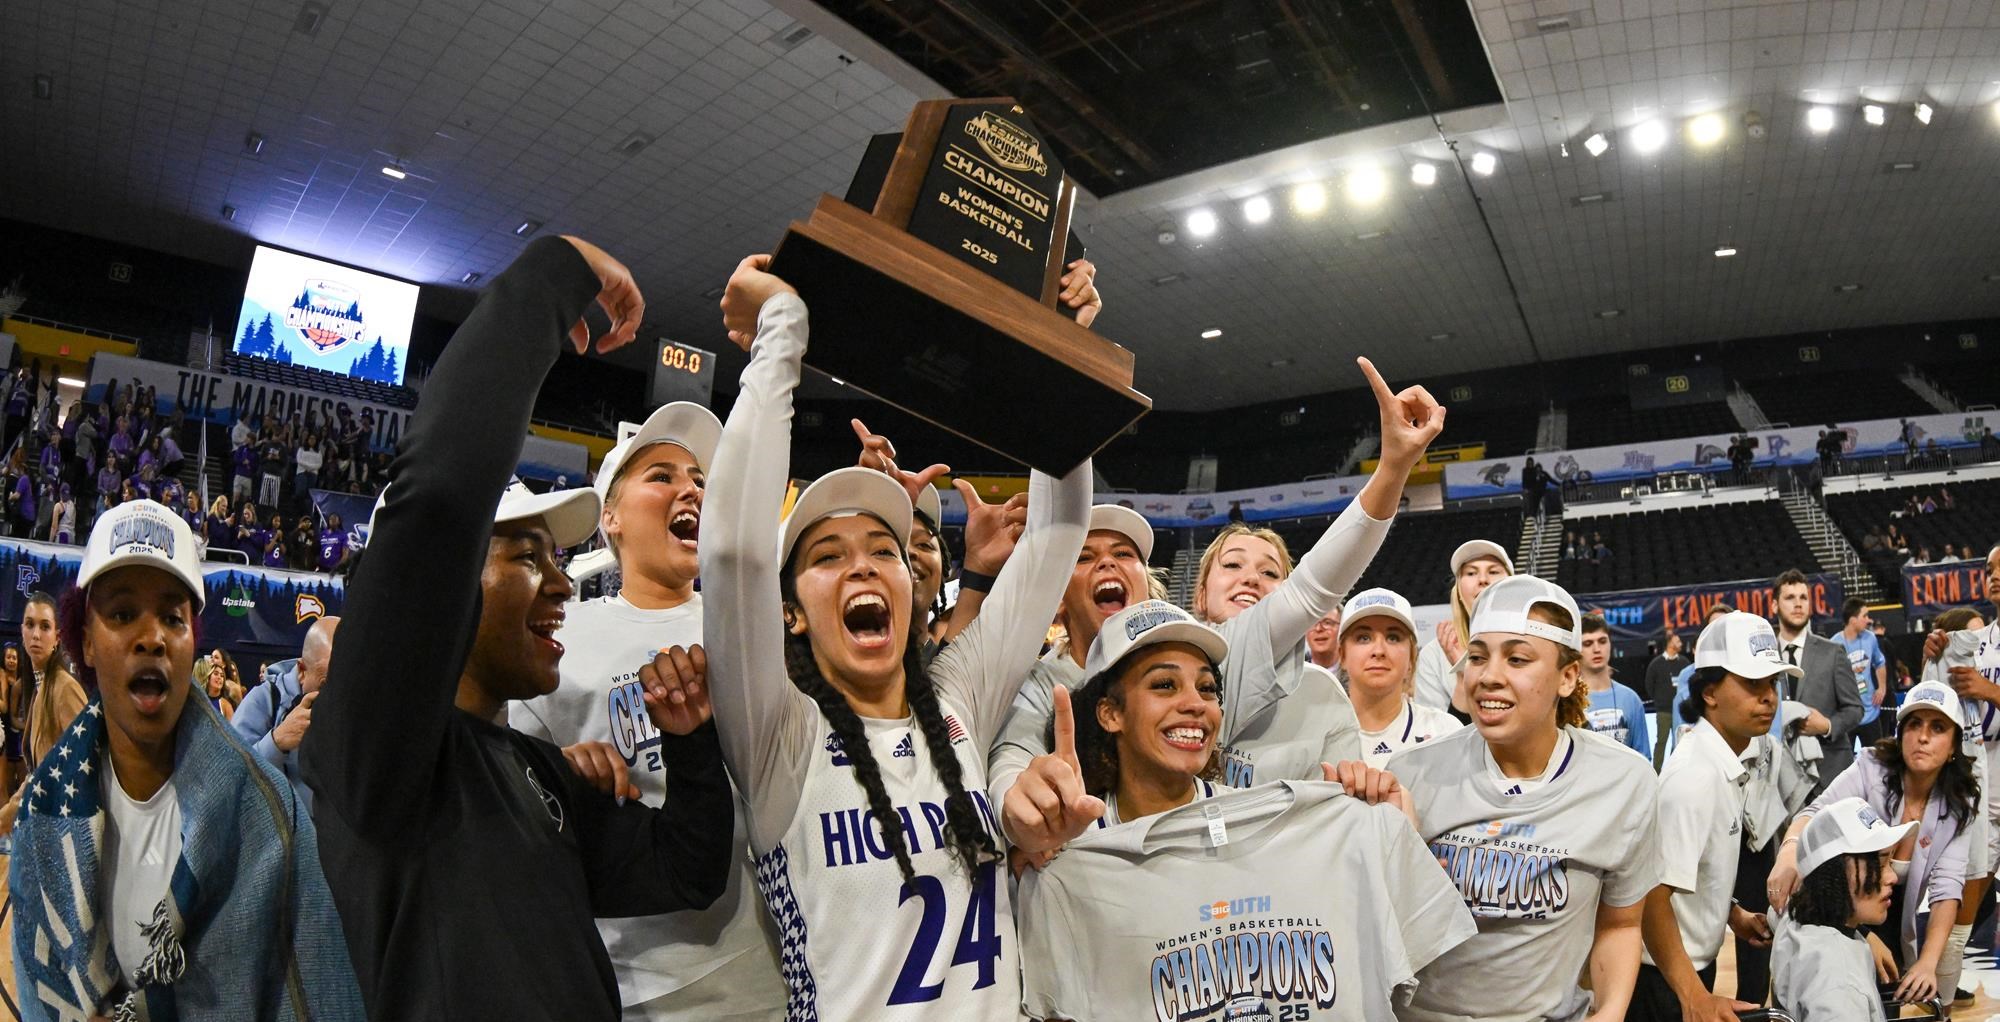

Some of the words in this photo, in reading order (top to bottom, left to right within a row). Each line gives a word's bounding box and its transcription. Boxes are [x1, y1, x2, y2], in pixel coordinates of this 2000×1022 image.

[964, 121, 1048, 177] CHAMPIONSHIPS
[945, 151, 1049, 217] CHAMPION
[938, 192, 1034, 251] BASKETBALL
[958, 186, 1024, 230] WOMEN'S
[961, 238, 999, 264] 2025
[662, 345, 701, 374] 00.0
[177, 370, 223, 419] THE
[1669, 378, 1686, 389] 20
[273, 547, 280, 559] 6
[324, 546, 332, 559] 6
[1911, 569, 1961, 606] EARN
[819, 807, 922, 868] HIGH
[1494, 838, 1570, 856] BASKETBALL
[1199, 896, 1272, 923] SOUTH
[1211, 903, 1231, 916] BIG
[886, 859, 1002, 1007] 24
[1155, 925, 1222, 951] WOMEN'S
[1229, 918, 1323, 932] BASKETBALL
[1151, 930, 1337, 1022] CHAMPIONS
[1278, 1003, 1310, 1022] 25
